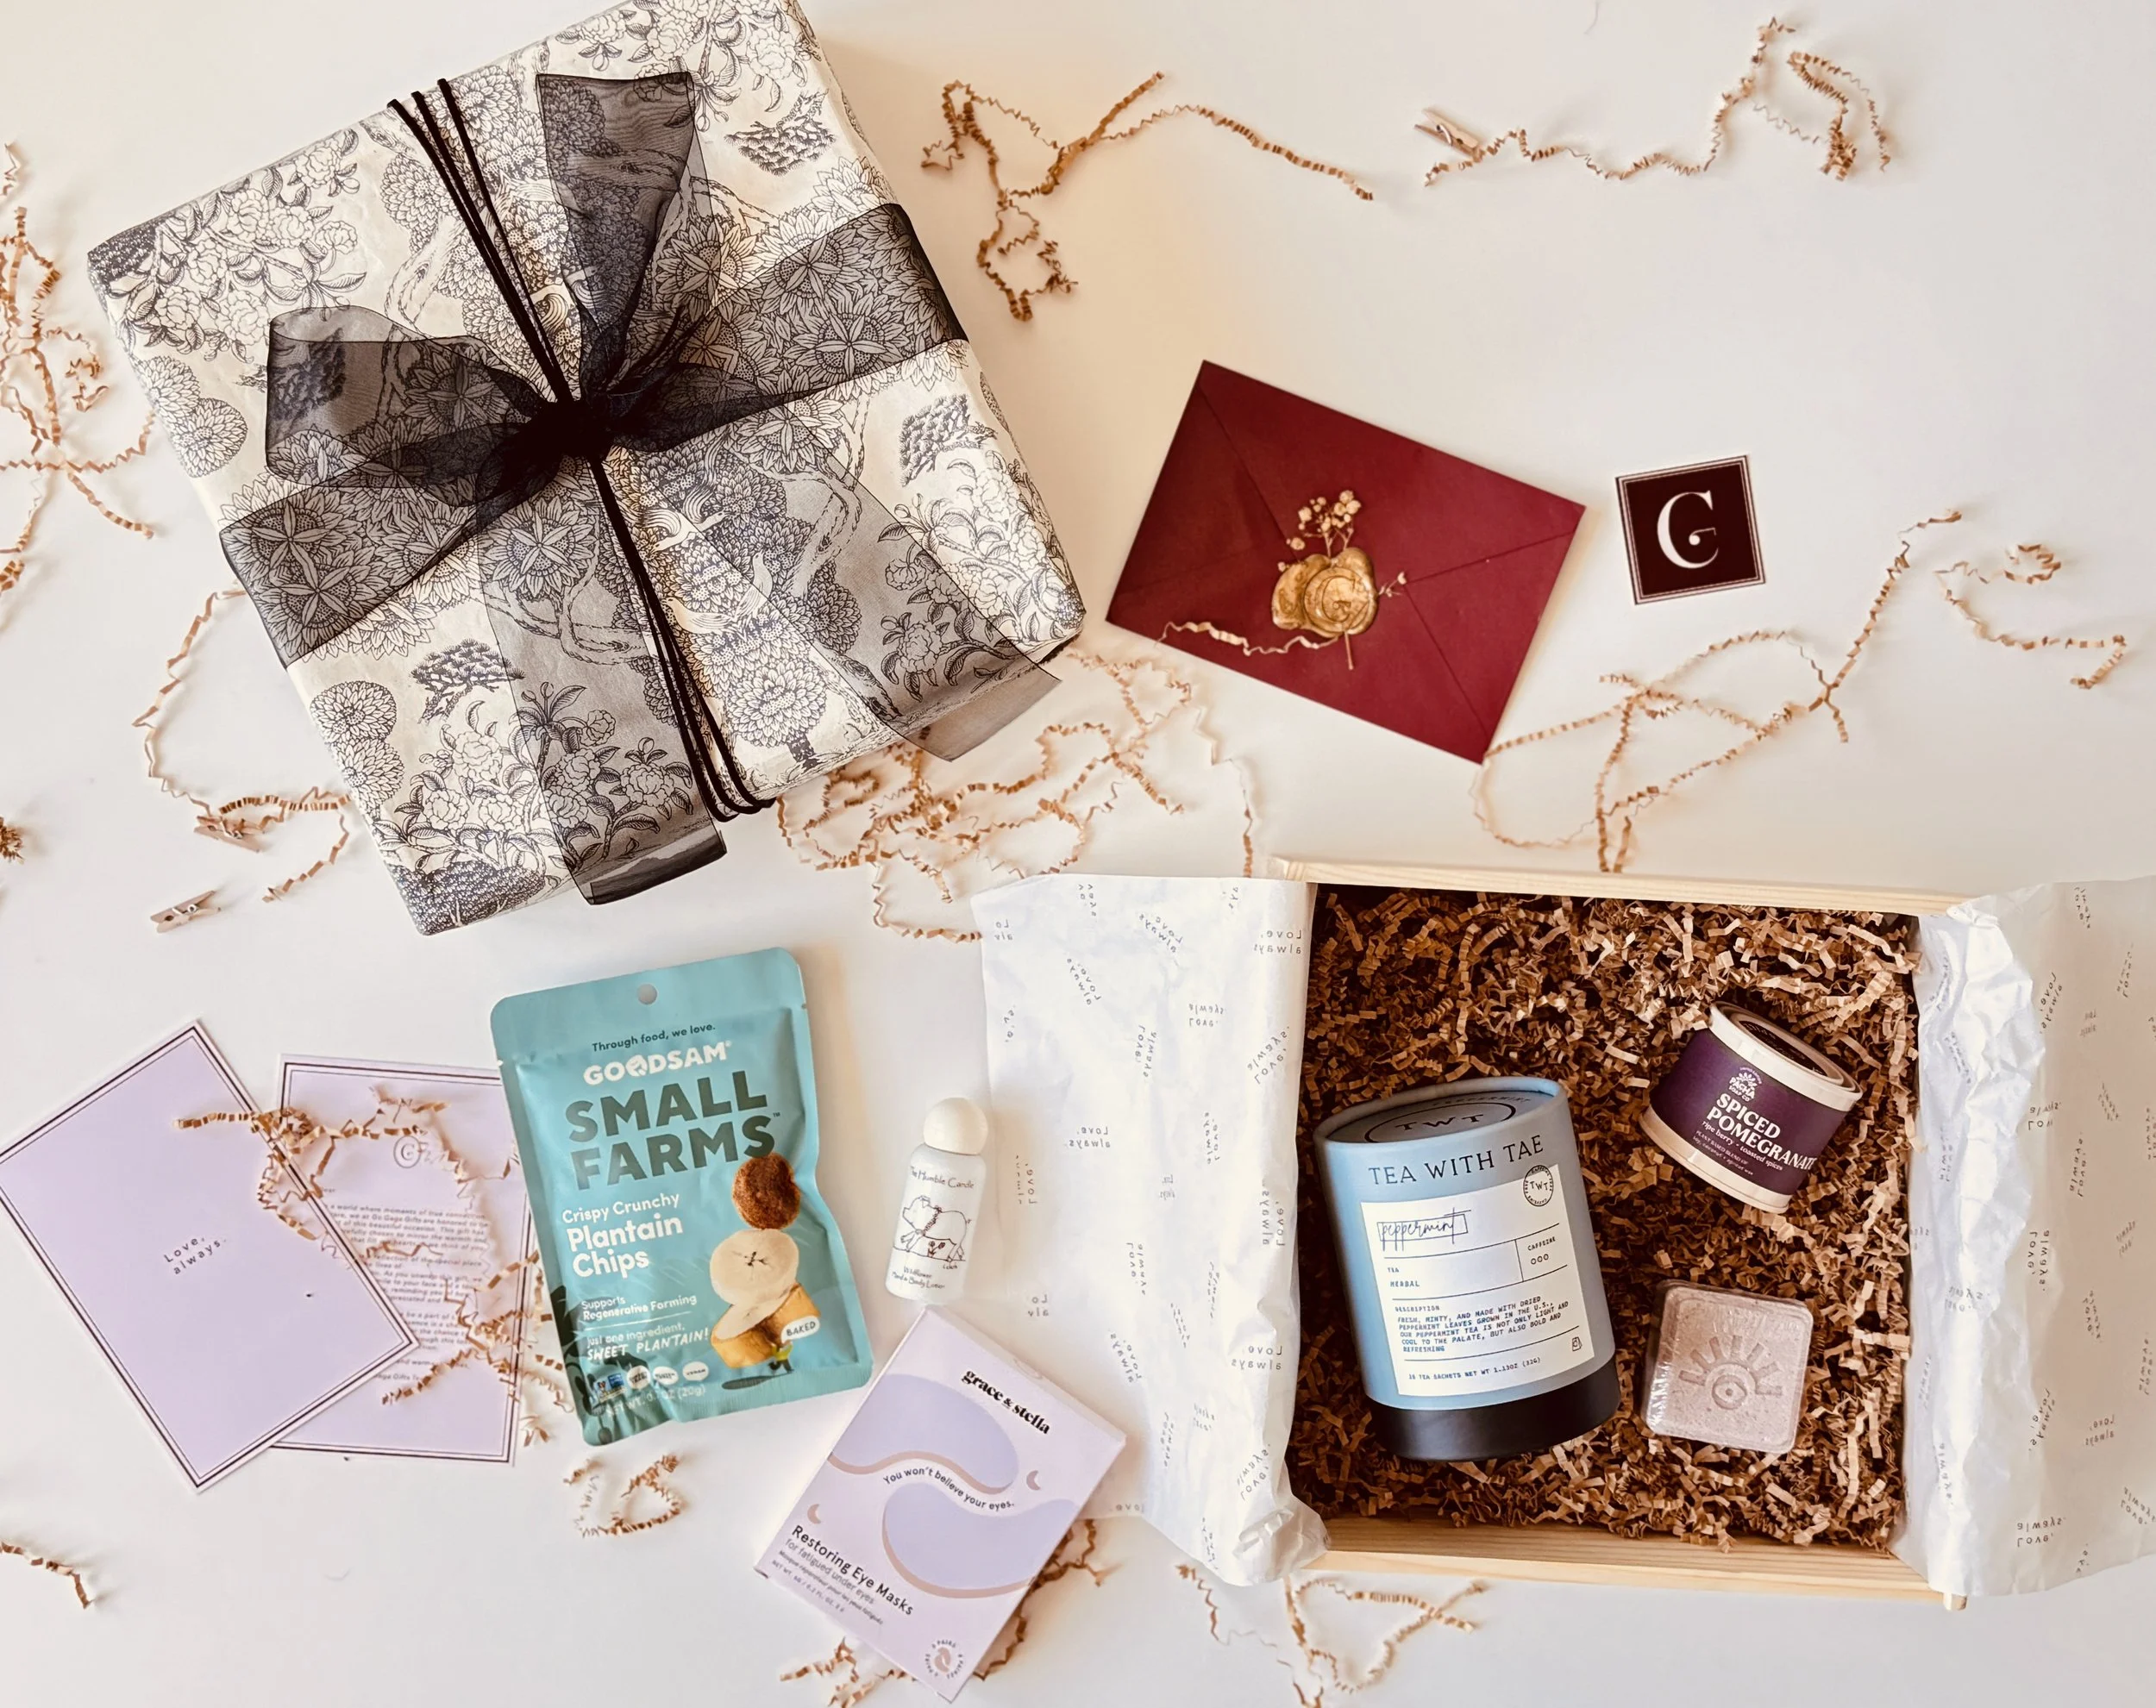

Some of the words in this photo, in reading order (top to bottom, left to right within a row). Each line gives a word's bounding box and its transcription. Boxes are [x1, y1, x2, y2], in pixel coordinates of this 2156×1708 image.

[1657, 490, 1719, 569] G
[592, 1037, 638, 1052] Through
[641, 1030, 669, 1043] food,
[672, 1028, 687, 1037] we
[690, 1023, 716, 1035] love.
[1728, 1085, 1742, 1096] SOAP
[1729, 1076, 1755, 1099] PACHA
[565, 1070, 768, 1142] SMALL
[1716, 1092, 1781, 1139] SPICED
[1395, 1114, 1483, 1130] TWT
[571, 1115, 775, 1191] FARMS
[1369, 1166, 1417, 1185] TEA
[1424, 1150, 1495, 1179] WITH
[1503, 1135, 1544, 1162] TAE
[1702, 1121, 1715, 1133] ripe
[1715, 1129, 1735, 1146] berry
[1740, 1146, 1766, 1163] toasted
[1765, 1159, 1783, 1171] spices
[1530, 1181, 1548, 1190] TWT
[562, 1207, 609, 1223] Crispy
[612, 1193, 680, 1216] Crunchy
[566, 1212, 683, 1252] Plantain
[1381, 1208, 1471, 1252] peppermint
[1527, 1236, 1556, 1251] CAFFEINE
[573, 1248, 649, 1279] Chips
[581, 1296, 626, 1311] Supports
[583, 1303, 649, 1321] Regenerative
[650, 1295, 698, 1311] Farming
[1415, 1329, 1459, 1337] PEPPERMINT
[1514, 1314, 1532, 1324] ONLY
[1535, 1306, 1554, 1318] LIGHT
[1557, 1301, 1569, 1310] AND
[1475, 1308, 1494, 1317] MADE
[1498, 1303, 1516, 1312] WITH
[1520, 1296, 1541, 1307] DRIED
[787, 1321, 816, 1336] BAKED
[1451, 1333, 1485, 1343] PALATE,
[1507, 1323, 1526, 1334] ALSO
[1530, 1317, 1546, 1328] BOLD
[1550, 1312, 1562, 1322] AND
[1476, 1315, 1500, 1324] GROWN
[586, 1344, 628, 1361] SWEET
[636, 1328, 709, 1354] PLANTAIN!
[605, 1334, 624, 1343] one
[962, 1371, 1003, 1402] grace
[1012, 1405, 1050, 1434] stella
[883, 1473, 903, 1485] You
[904, 1467, 933, 1477] won't
[934, 1472, 964, 1497] believe
[965, 1493, 987, 1509] your
[988, 1499, 1015, 1511] eyes.
[785, 1538, 799, 1551] for
[799, 1547, 832, 1574] fatigued
[831, 1571, 857, 1592] under
[856, 1588, 874, 1605] eyes
[792, 1524, 852, 1574] Restoring
[852, 1567, 874, 1588] Eye
[876, 1583, 914, 1616] Masks
